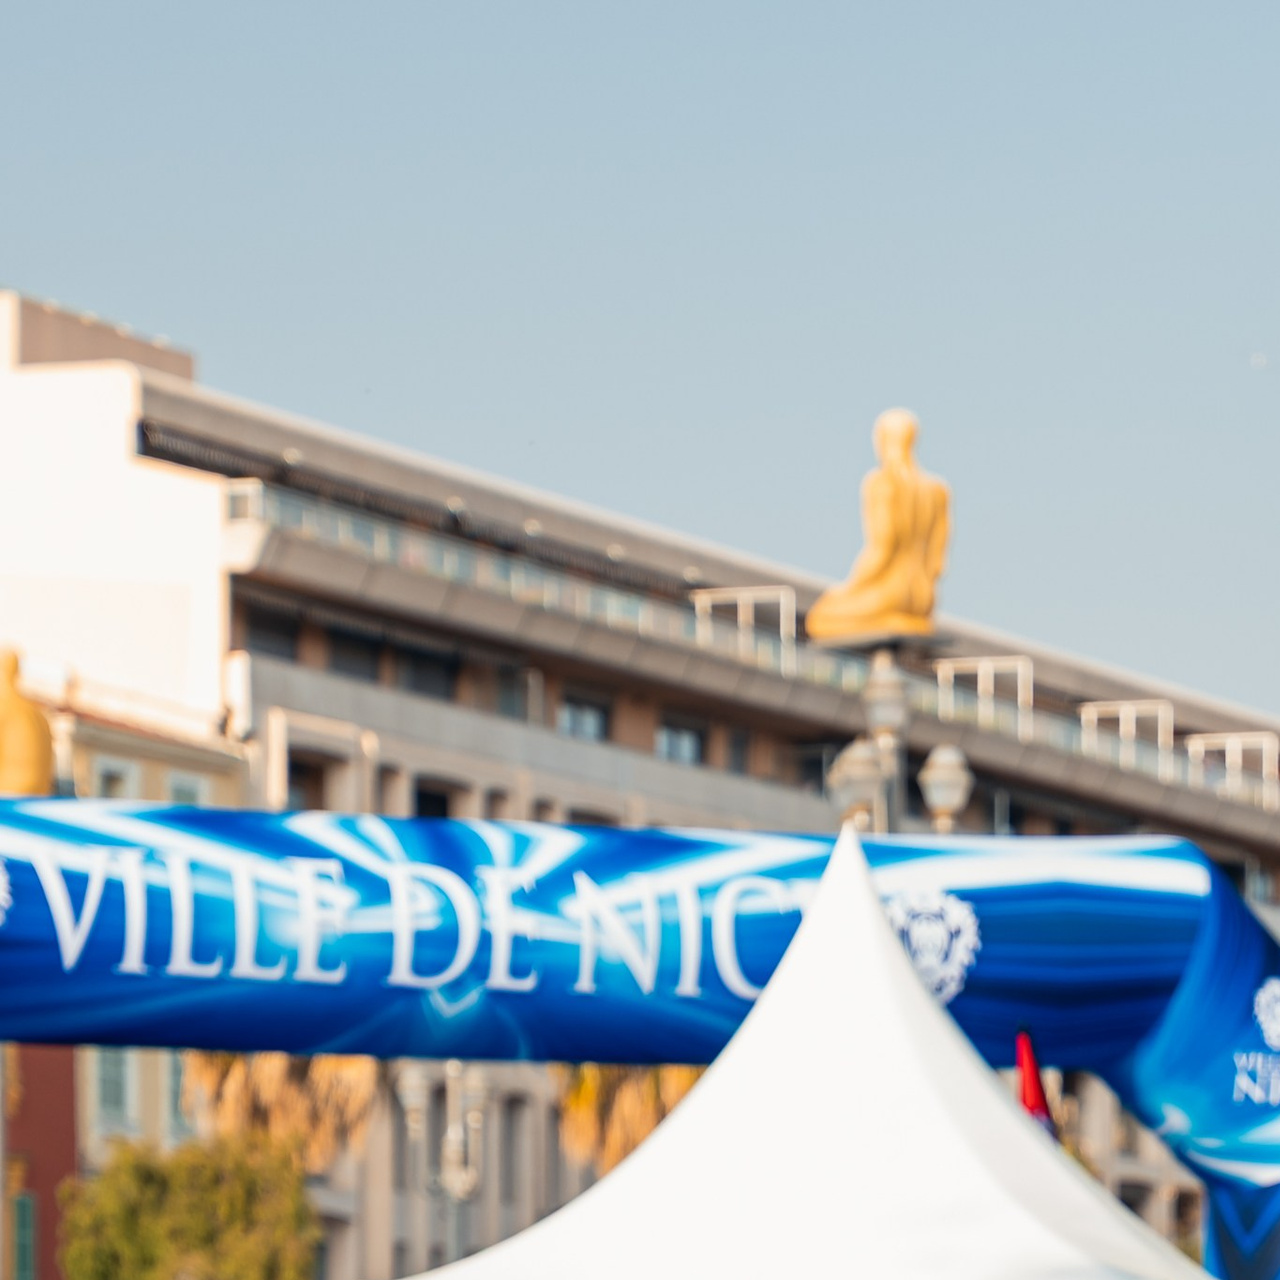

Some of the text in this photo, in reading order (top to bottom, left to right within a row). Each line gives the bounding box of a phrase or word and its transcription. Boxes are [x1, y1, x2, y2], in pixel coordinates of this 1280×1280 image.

[30, 847, 818, 1003] VILLE DE NIC
